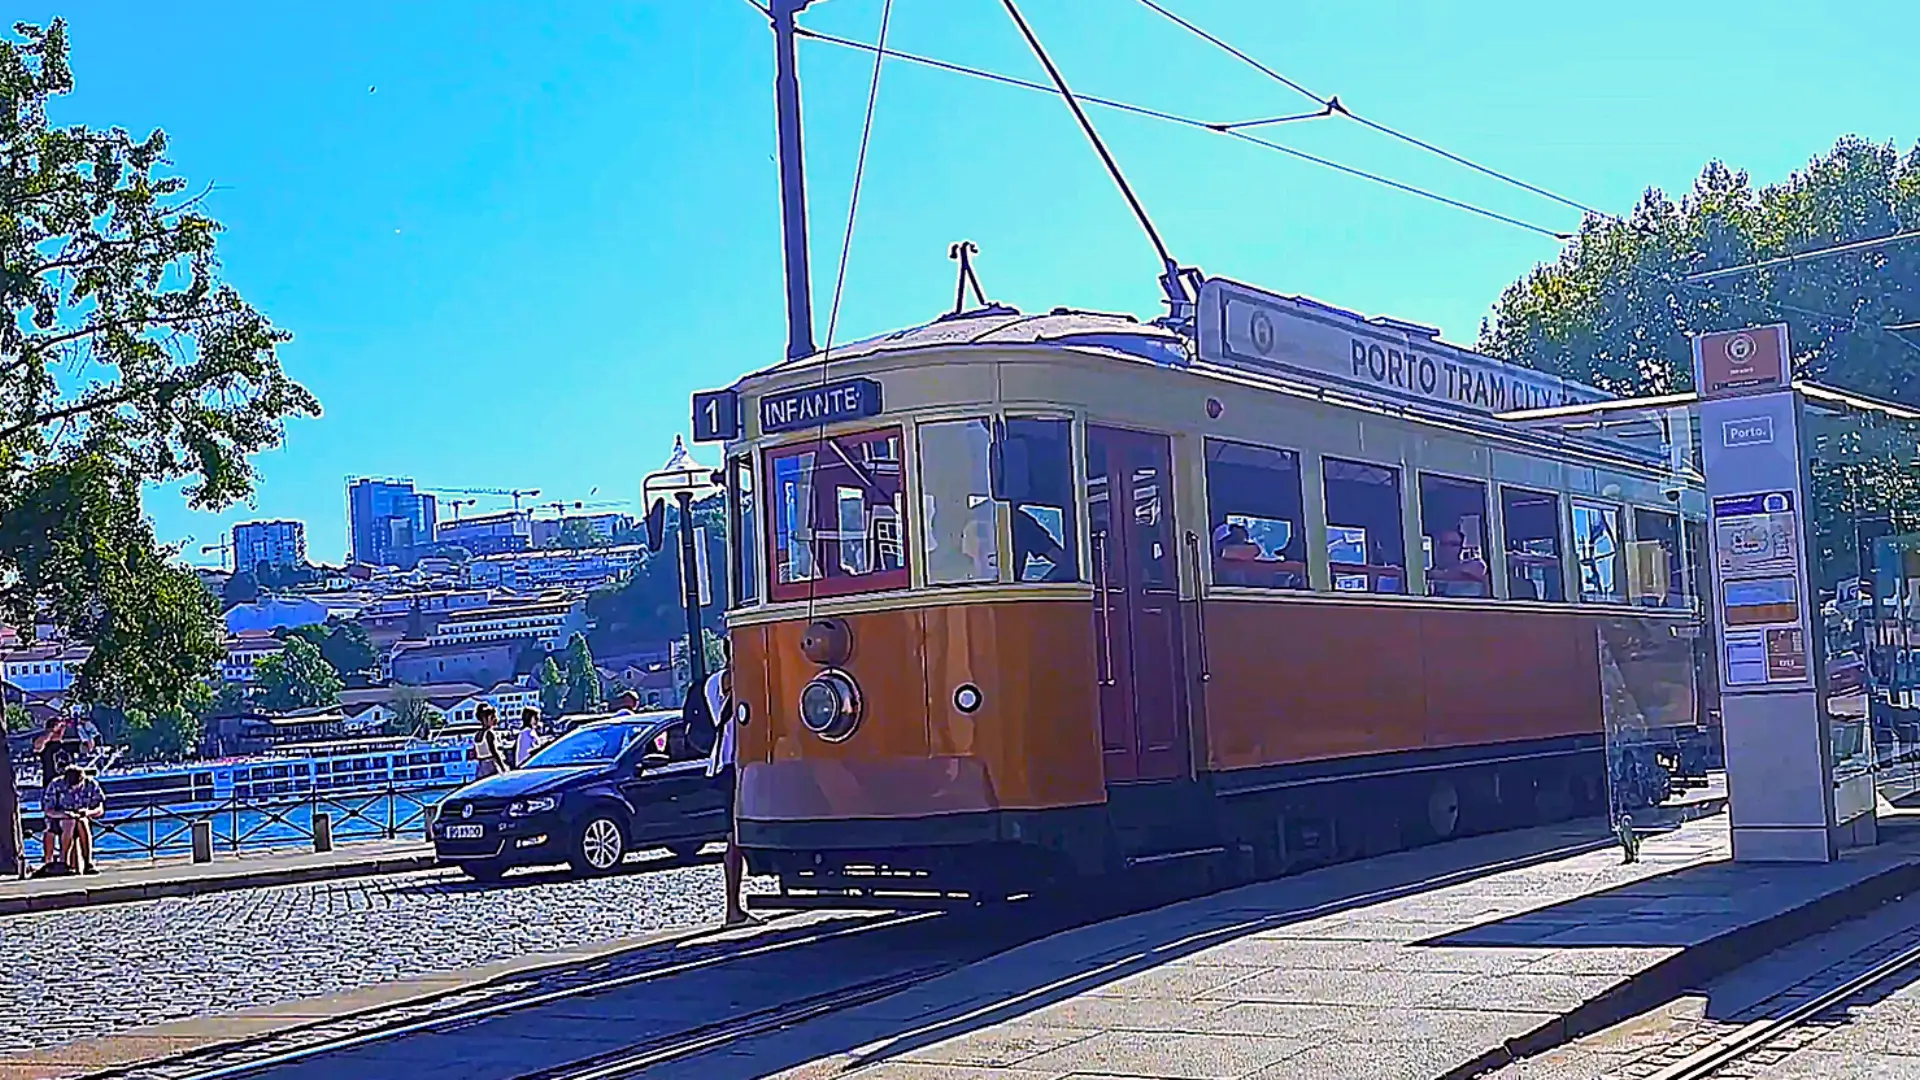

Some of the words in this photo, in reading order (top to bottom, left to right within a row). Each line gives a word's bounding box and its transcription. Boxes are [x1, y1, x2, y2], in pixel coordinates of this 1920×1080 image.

[1351, 338, 1437, 395] PORTO
[1443, 362, 1505, 411] TRAM
[705, 399, 718, 434] 1
[764, 386, 857, 427] INFANTE
[1730, 426, 1767, 439] Porto.
